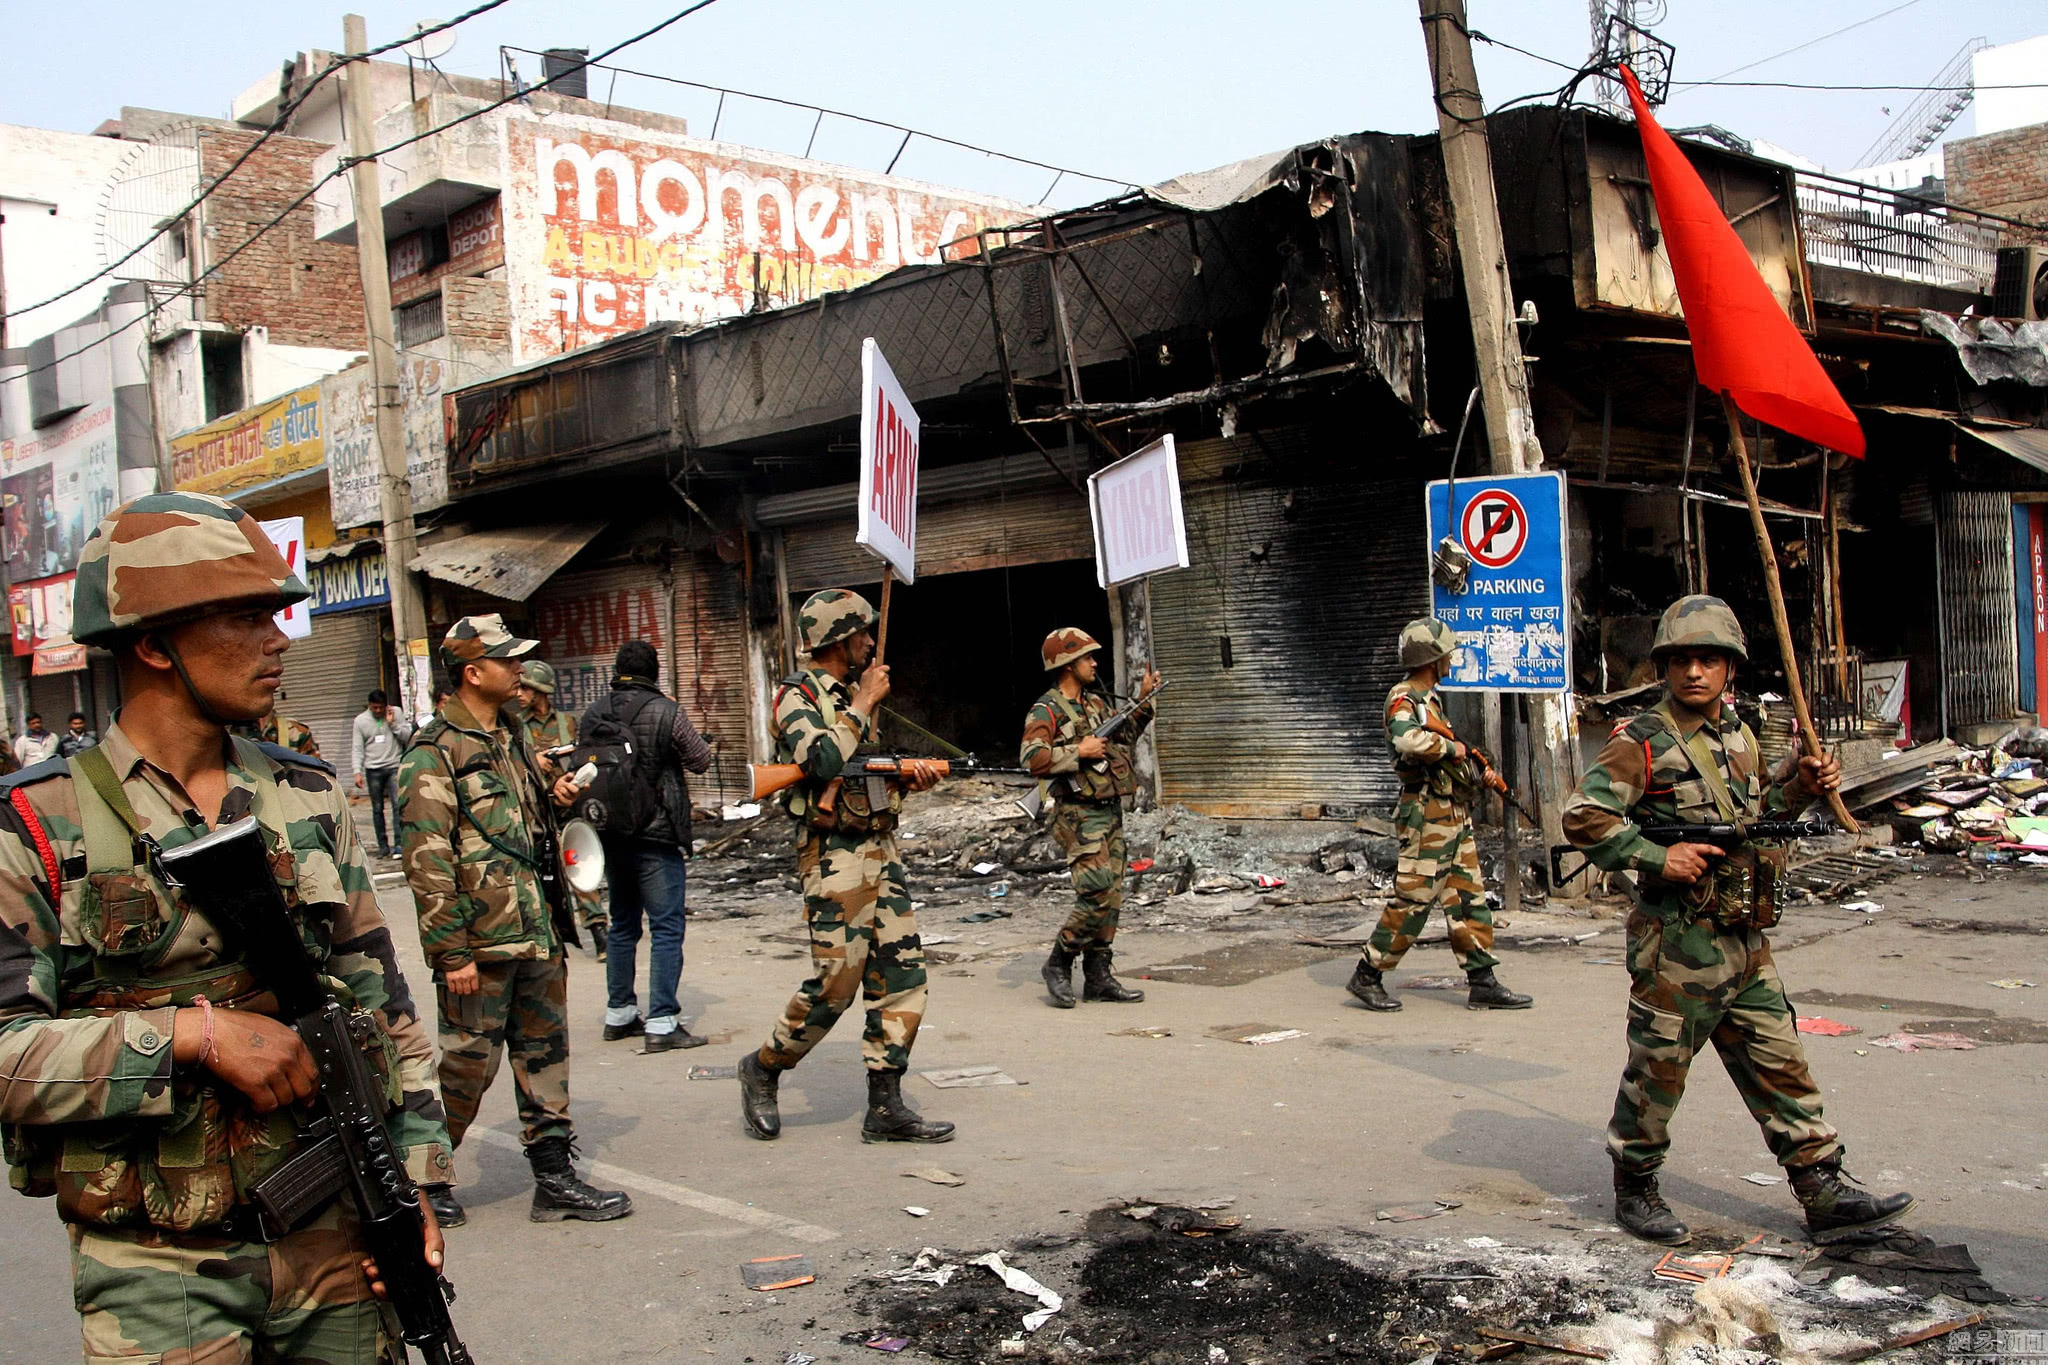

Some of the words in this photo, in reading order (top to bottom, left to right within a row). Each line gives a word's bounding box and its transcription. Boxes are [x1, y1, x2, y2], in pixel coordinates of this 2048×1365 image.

[452, 223, 499, 258] DEPOT
[453, 204, 495, 237] BOOK
[542, 228, 574, 267] A
[736, 249, 892, 299] COMFO
[198, 436, 226, 476] शराब
[285, 395, 319, 445] बीयर
[871, 385, 919, 550] ARMY
[323, 558, 361, 605] BOOK
[362, 553, 387, 597] DEP
[1447, 582, 1469, 596] O
[1474, 578, 1545, 596] PARKING
[2034, 533, 2045, 633] APRON
[537, 587, 663, 659] PRIMA
[1437, 604, 1459, 622] यहां
[1465, 607, 1483, 620] पर
[1491, 607, 1523, 622] वाहन
